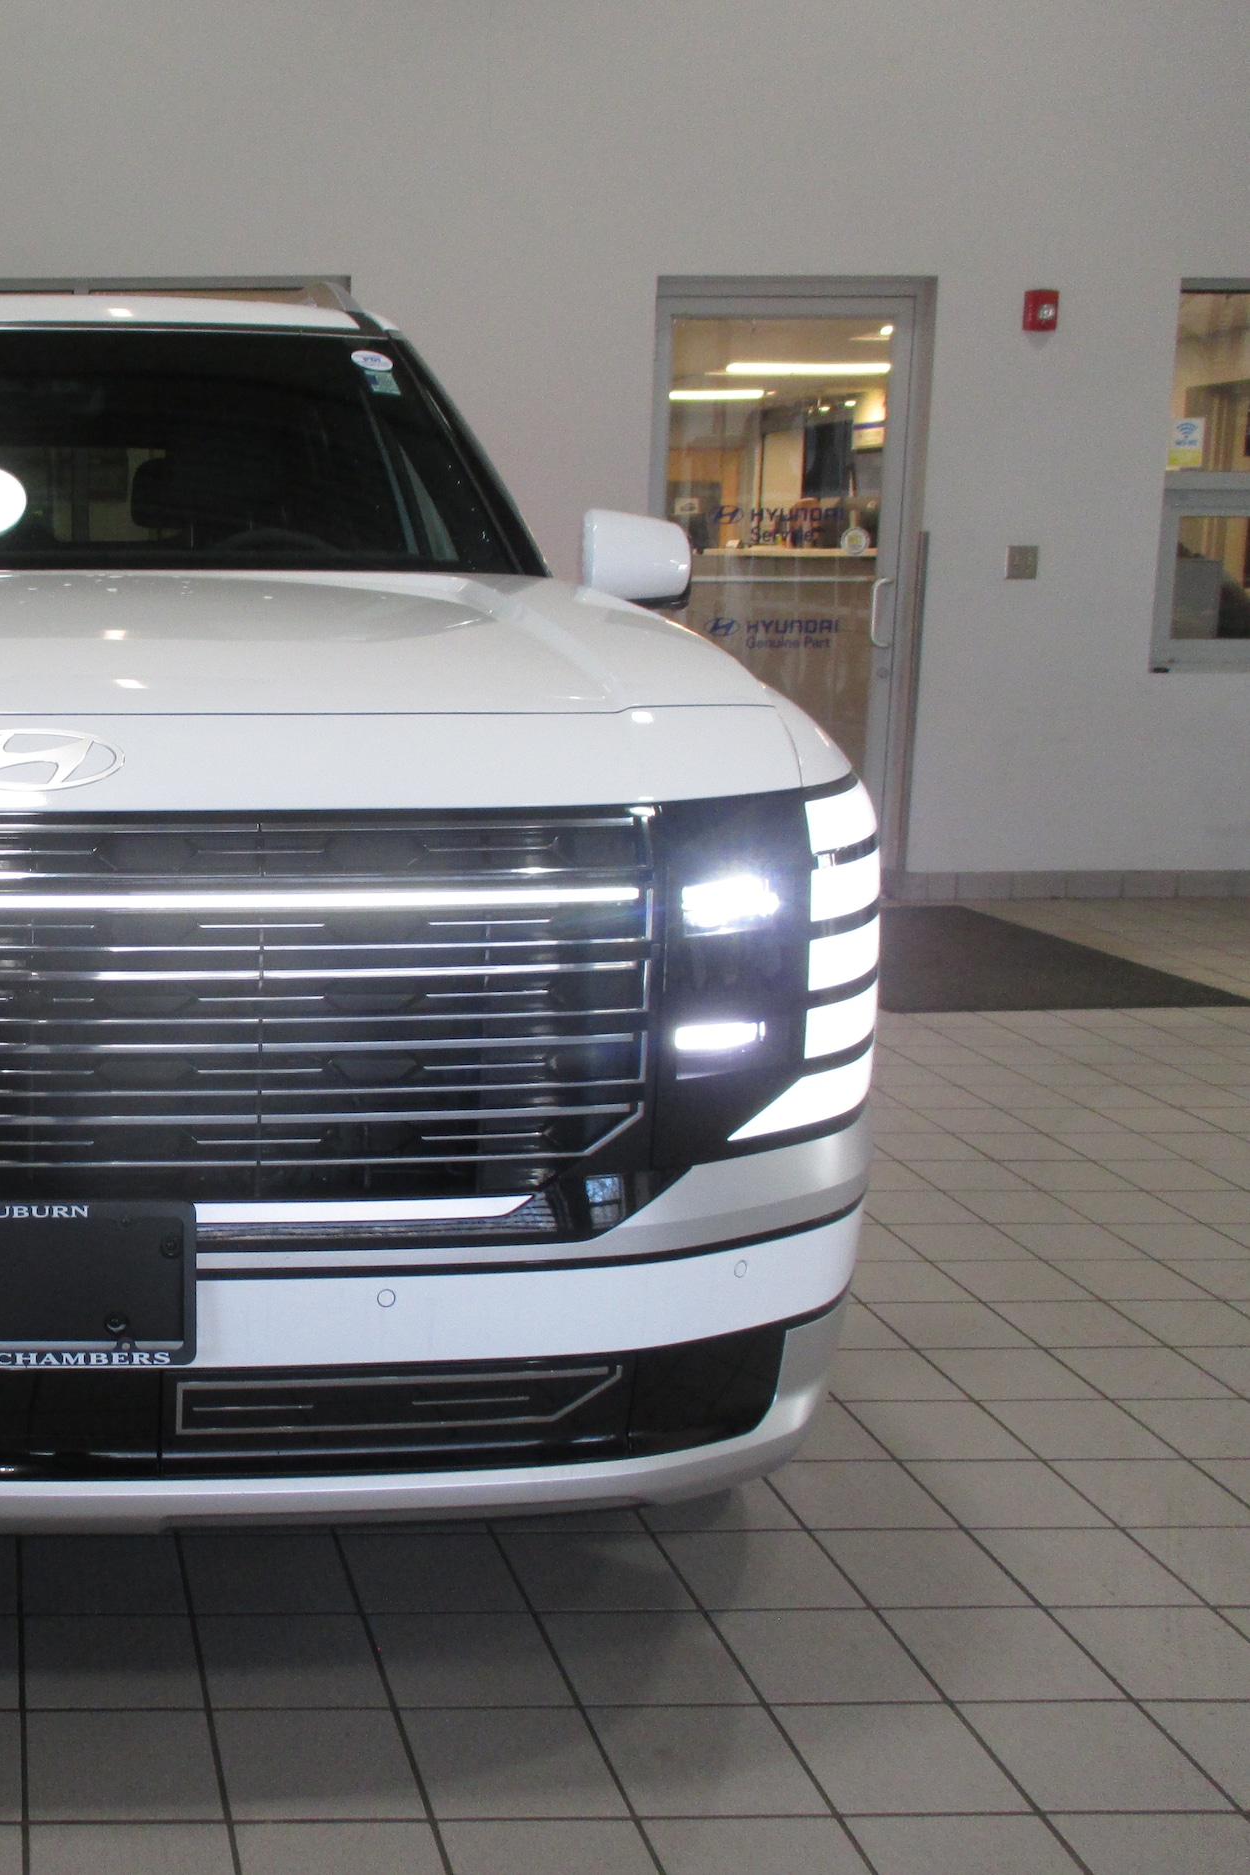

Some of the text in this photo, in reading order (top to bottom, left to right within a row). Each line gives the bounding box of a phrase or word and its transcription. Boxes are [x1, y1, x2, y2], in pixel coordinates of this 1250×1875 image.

[751, 507, 844, 522] HYUNDAI
[751, 526, 814, 544] Serve
[746, 619, 839, 634] HYUNDAI
